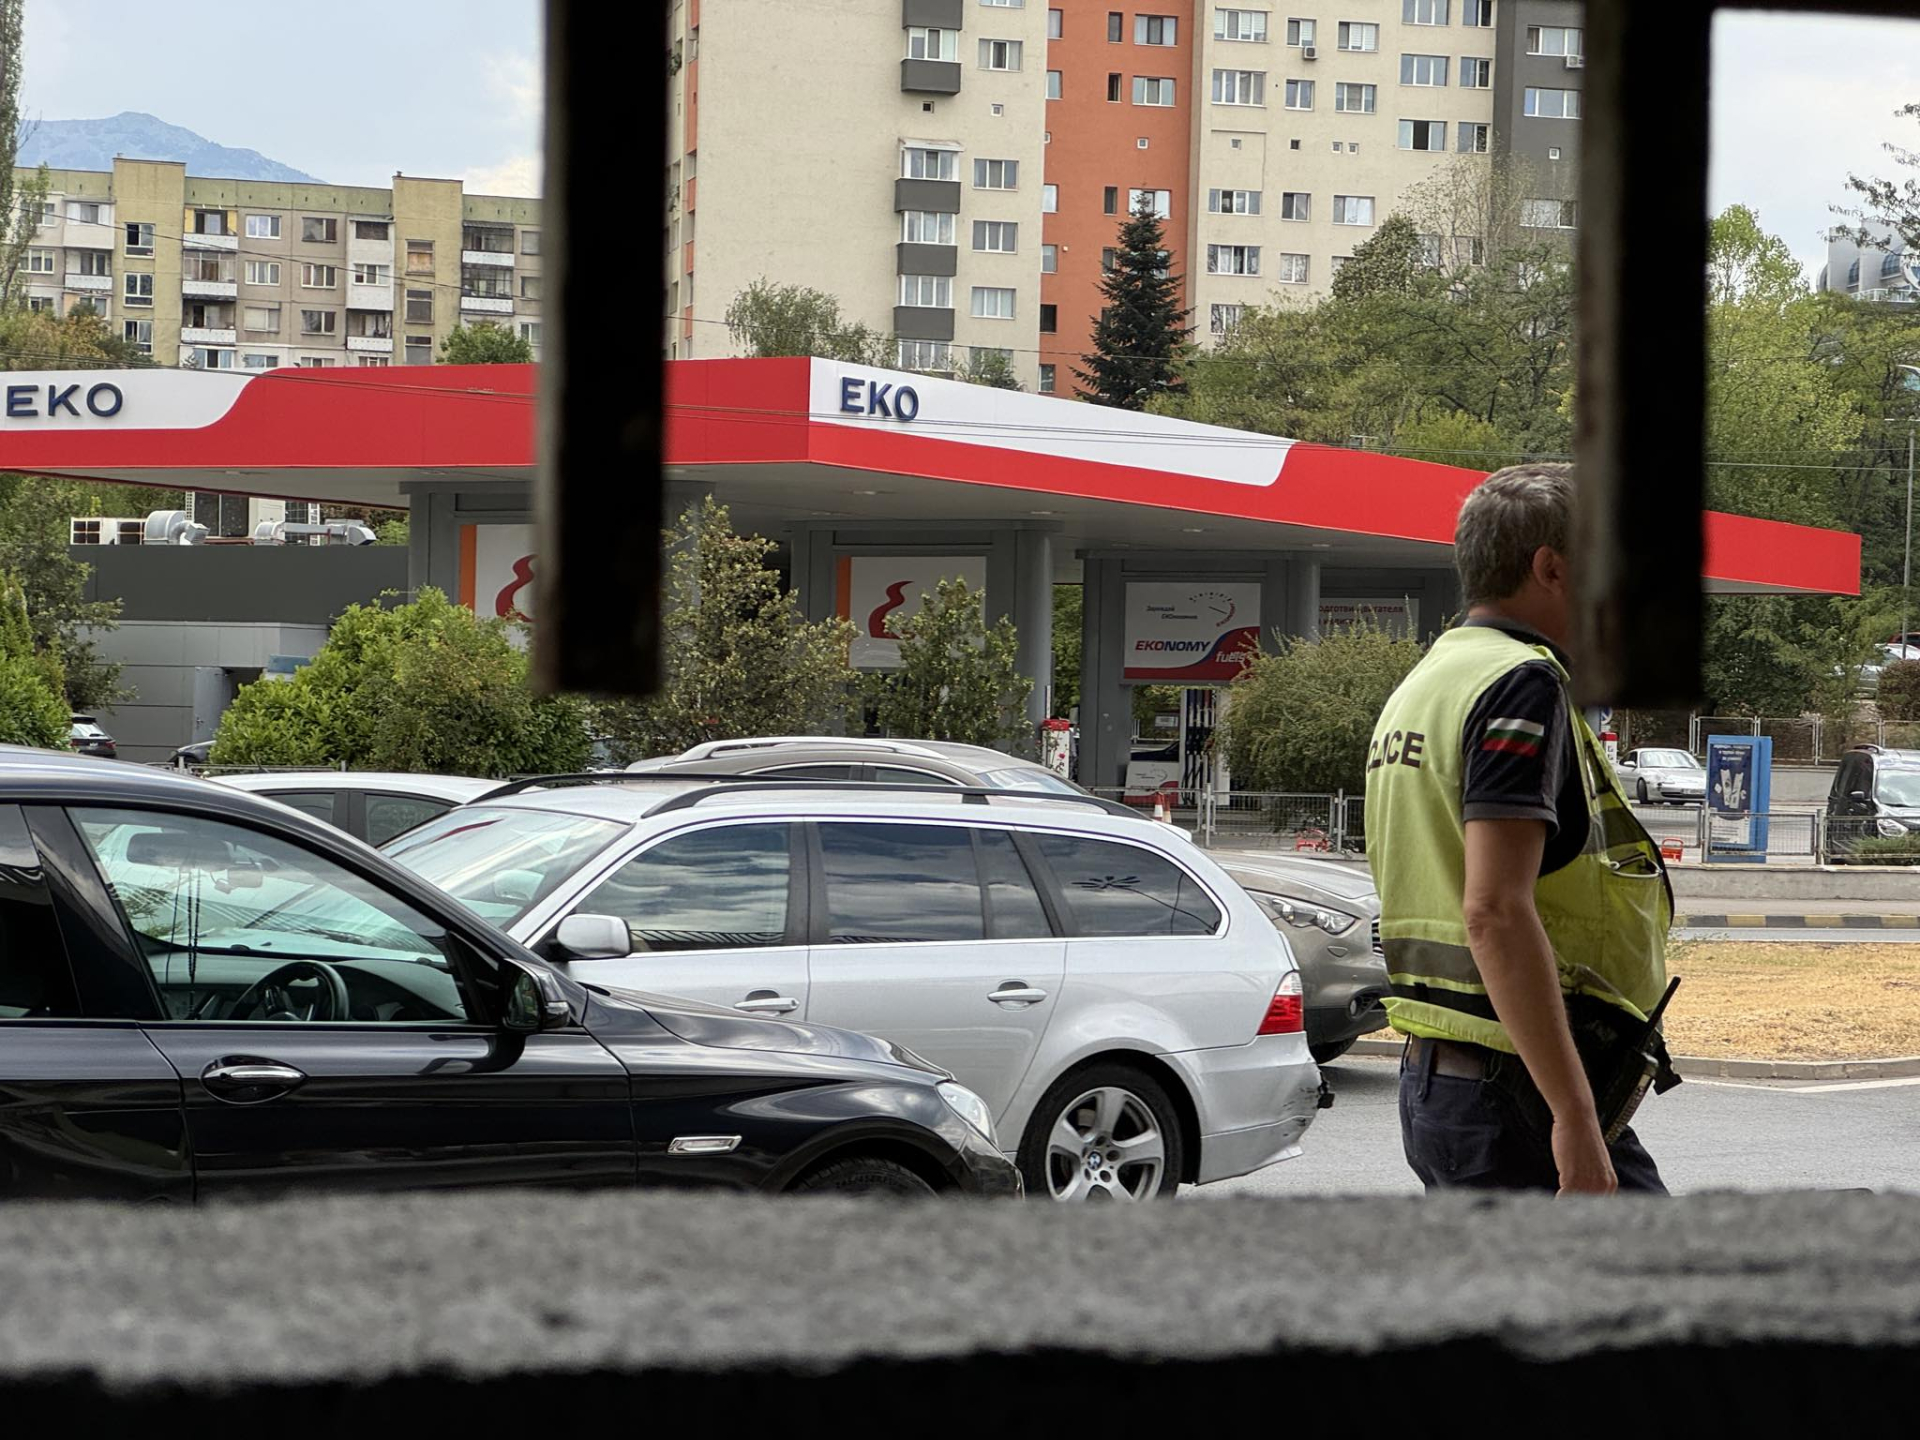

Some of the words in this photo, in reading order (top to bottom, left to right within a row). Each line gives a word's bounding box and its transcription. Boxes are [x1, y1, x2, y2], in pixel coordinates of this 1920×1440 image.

[6, 383, 123, 417] EKO
[841, 377, 919, 421] EKO
[1135, 640, 1210, 652] EKONOMY
[1215, 651, 1246, 663] fuels
[1367, 730, 1425, 773] LICE
